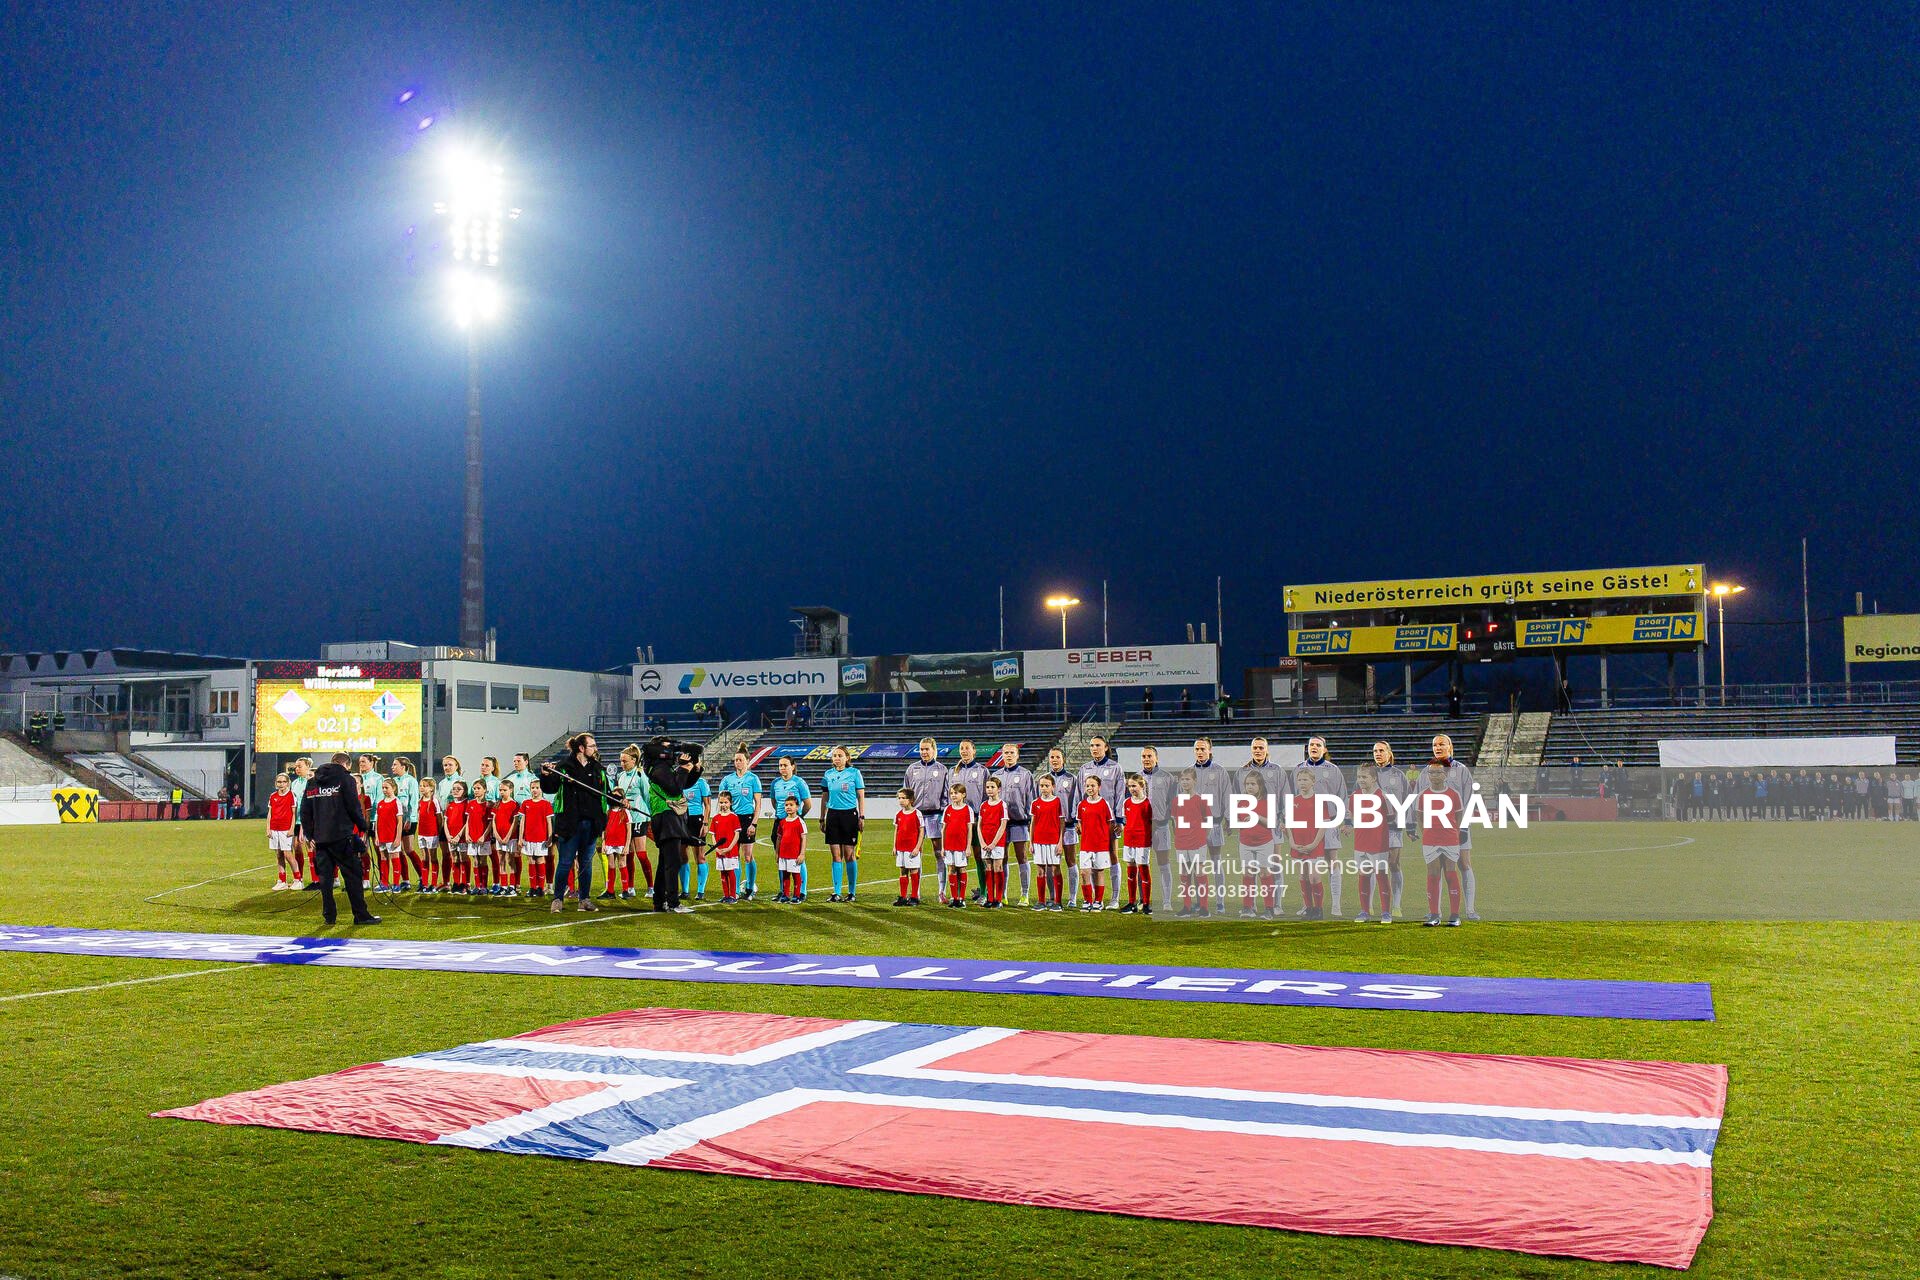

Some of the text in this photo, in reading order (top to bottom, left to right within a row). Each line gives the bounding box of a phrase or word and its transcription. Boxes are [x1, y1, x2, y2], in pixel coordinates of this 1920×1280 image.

[1314, 574, 1669, 604] Niederösterreich grüßt seine Gäste!
[1530, 623, 1557, 631] SPORT
[1638, 618, 1667, 626] SPORT
[1530, 635, 1553, 643] LAND
[1639, 630, 1662, 638] LAND
[1459, 643, 1476, 652] HEIM
[1855, 643, 1920, 659] Regiona
[1067, 650, 1153, 664] SIEBER
[710, 670, 825, 687] Westbahn
[1072, 671, 1149, 679] ABFALLWIRTSCHAFT
[316, 717, 362, 733] 02:15
[14, 936, 1449, 1000] EUROPEAN QUALIFIERS
